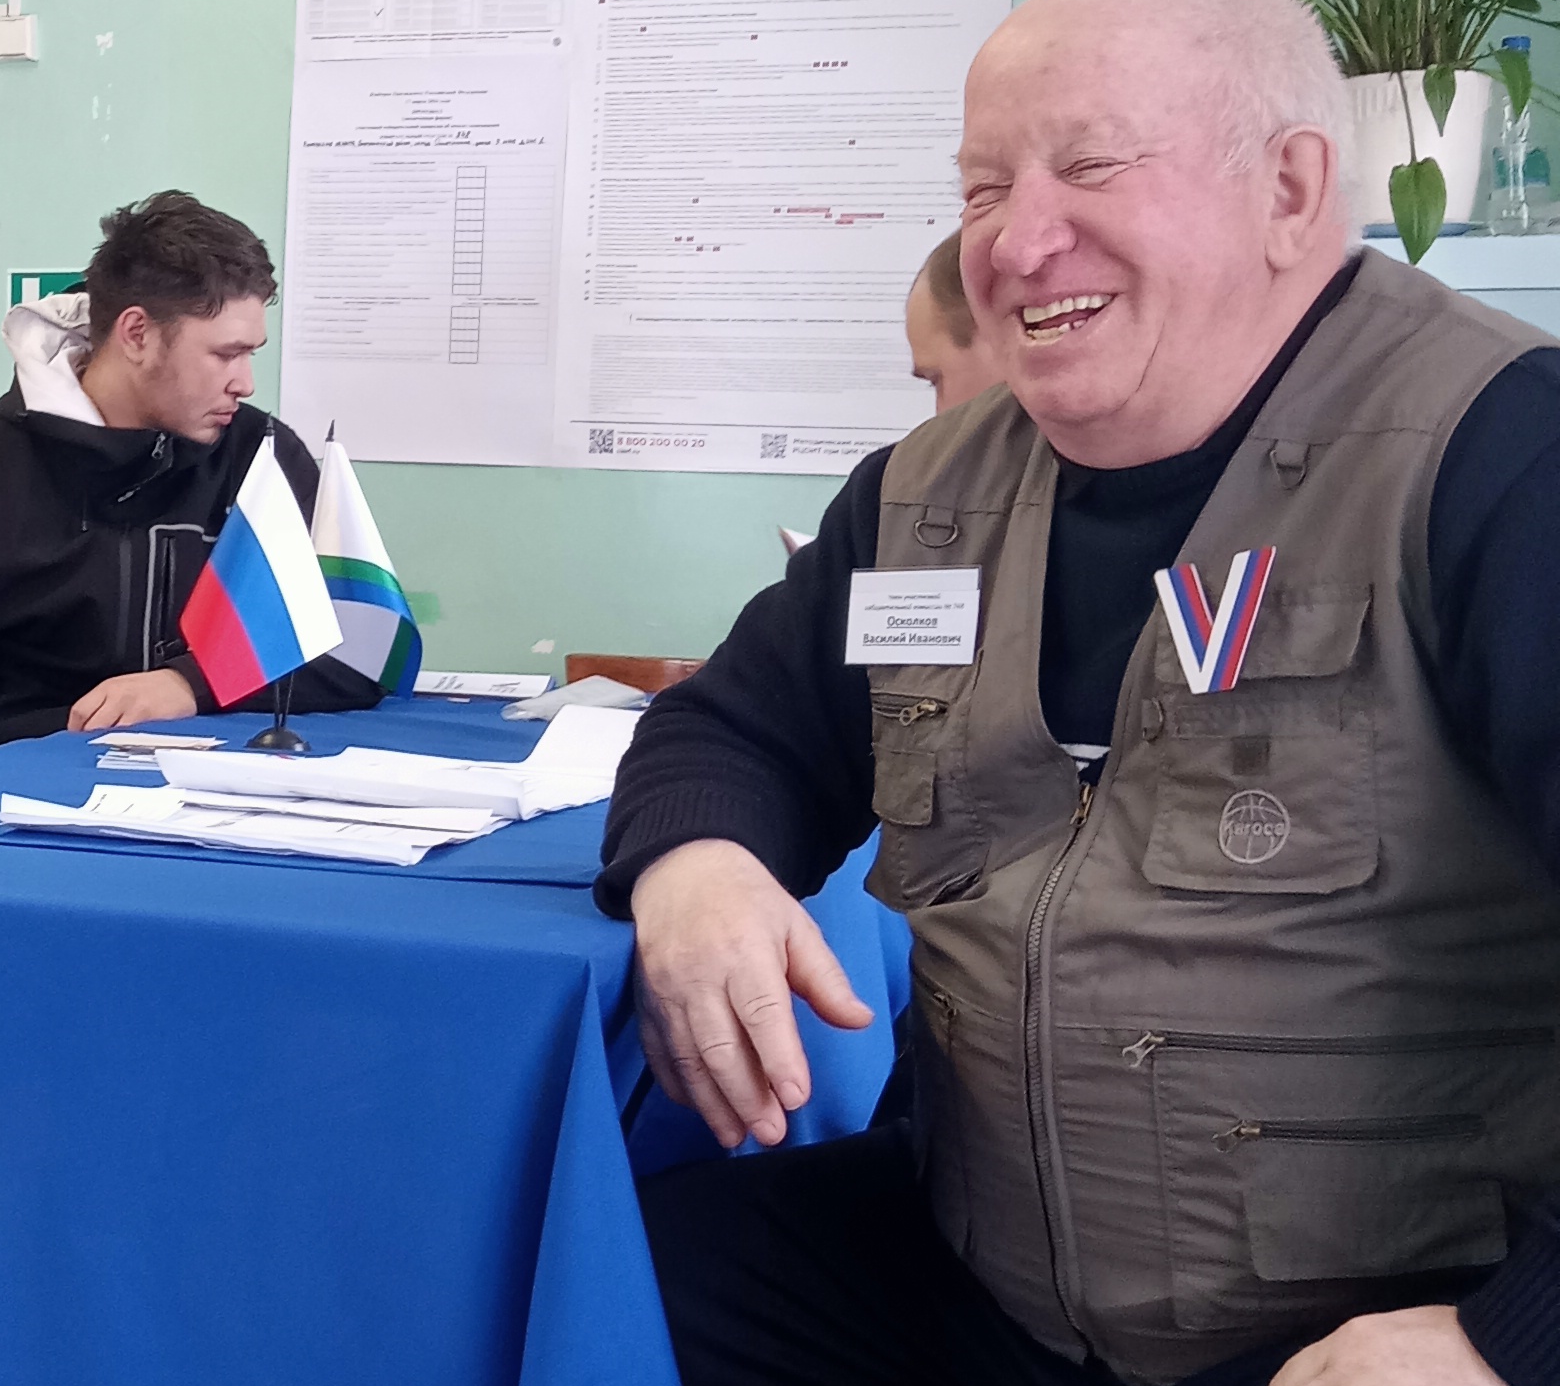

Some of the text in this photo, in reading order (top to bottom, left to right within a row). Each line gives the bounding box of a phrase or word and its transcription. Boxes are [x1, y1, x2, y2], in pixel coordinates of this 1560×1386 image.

[617, 437, 705, 448] 8 800 200 00 20
[887, 616, 938, 626] Осколков
[863, 633, 961, 643] Василий Иванович
